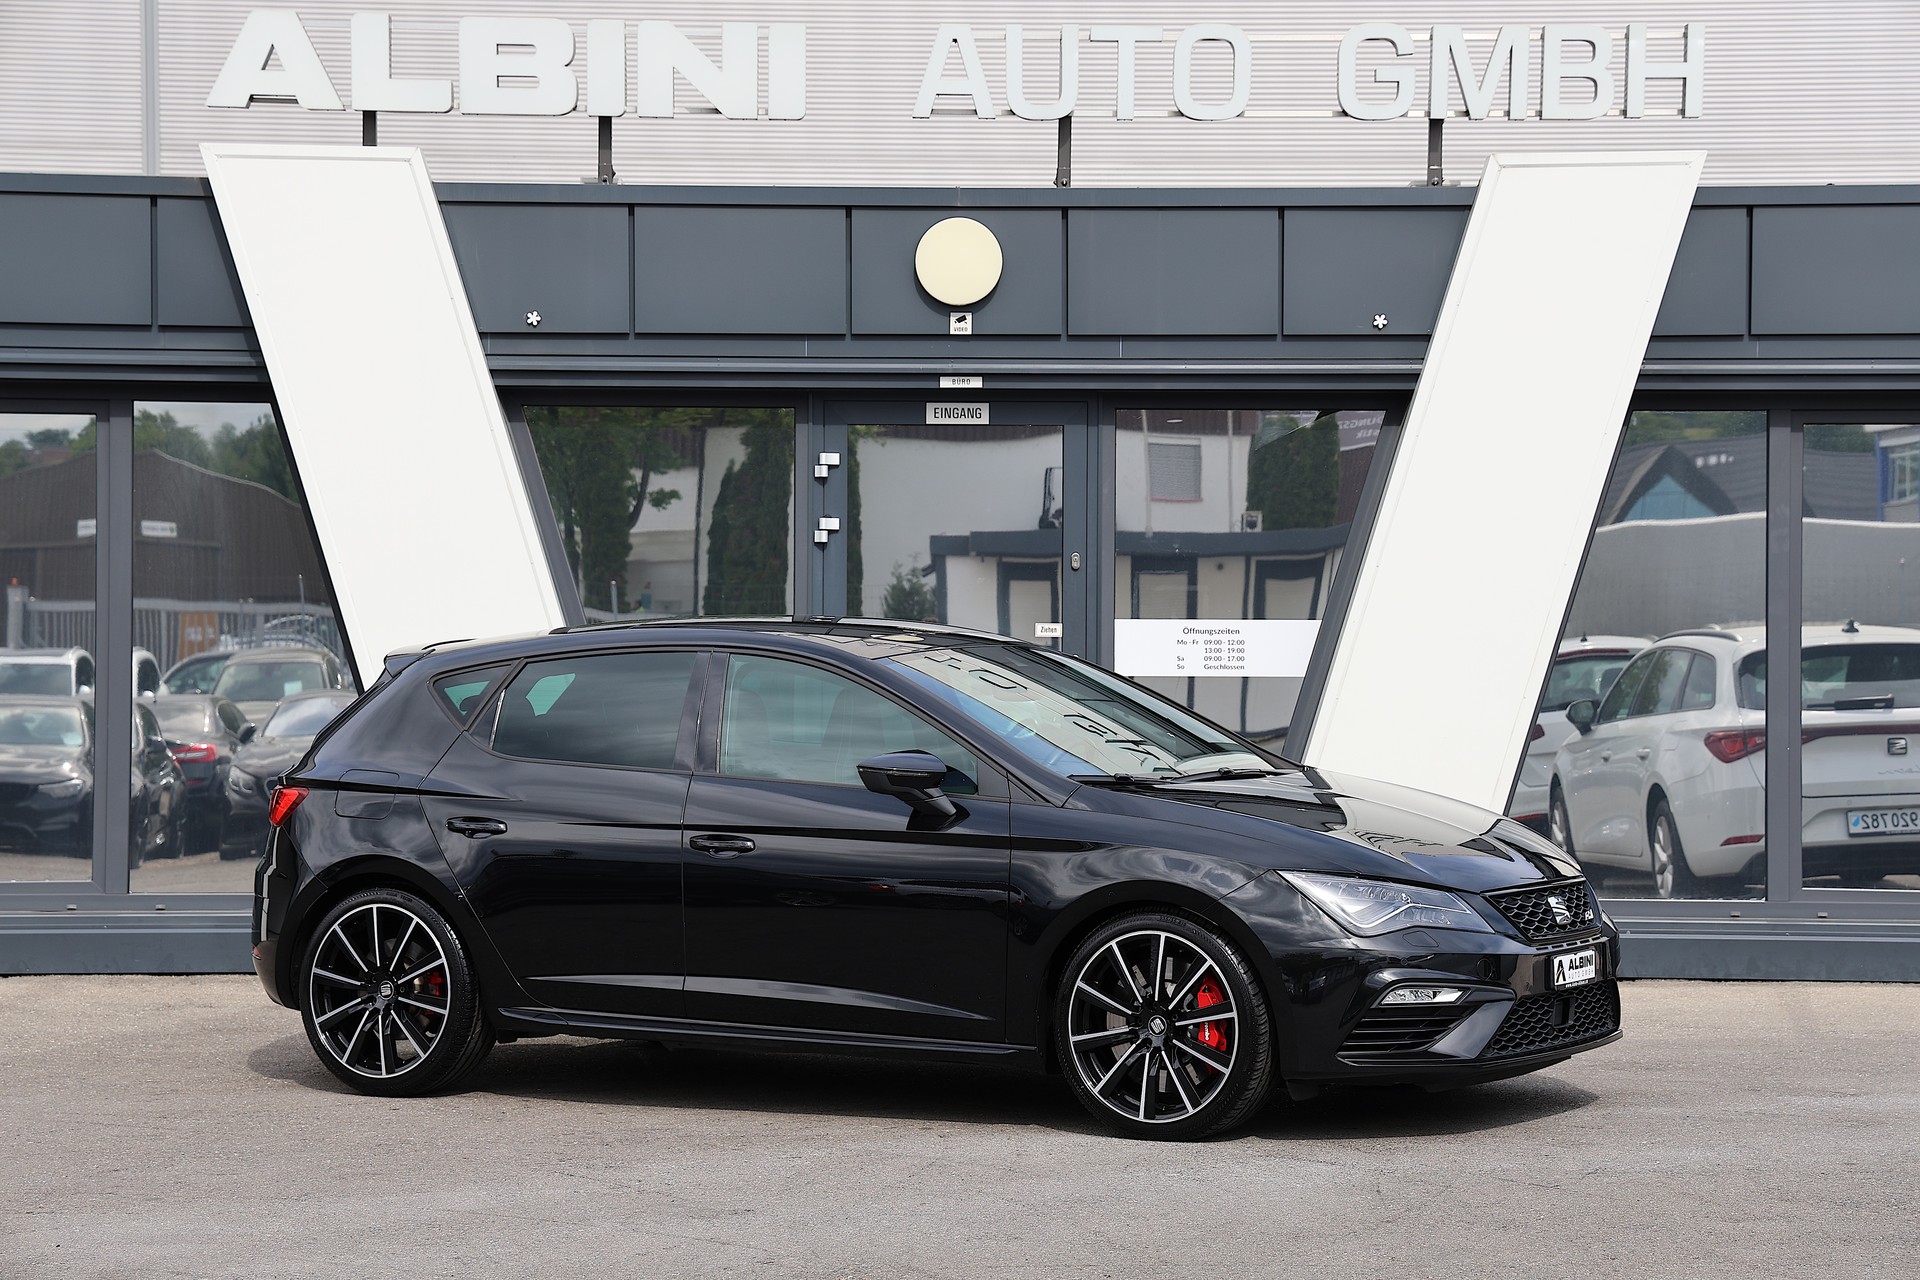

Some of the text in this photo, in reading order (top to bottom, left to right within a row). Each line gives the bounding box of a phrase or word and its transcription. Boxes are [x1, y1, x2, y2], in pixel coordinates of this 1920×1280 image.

[205, 9, 1707, 122] ALBINI AUTO GMBH
[933, 407, 982, 419] EINGANG
[1040, 625, 1058, 634] Ziehen
[1182, 625, 1240, 636] Öffnungszeiten
[1569, 954, 1593, 971] ALBINI
